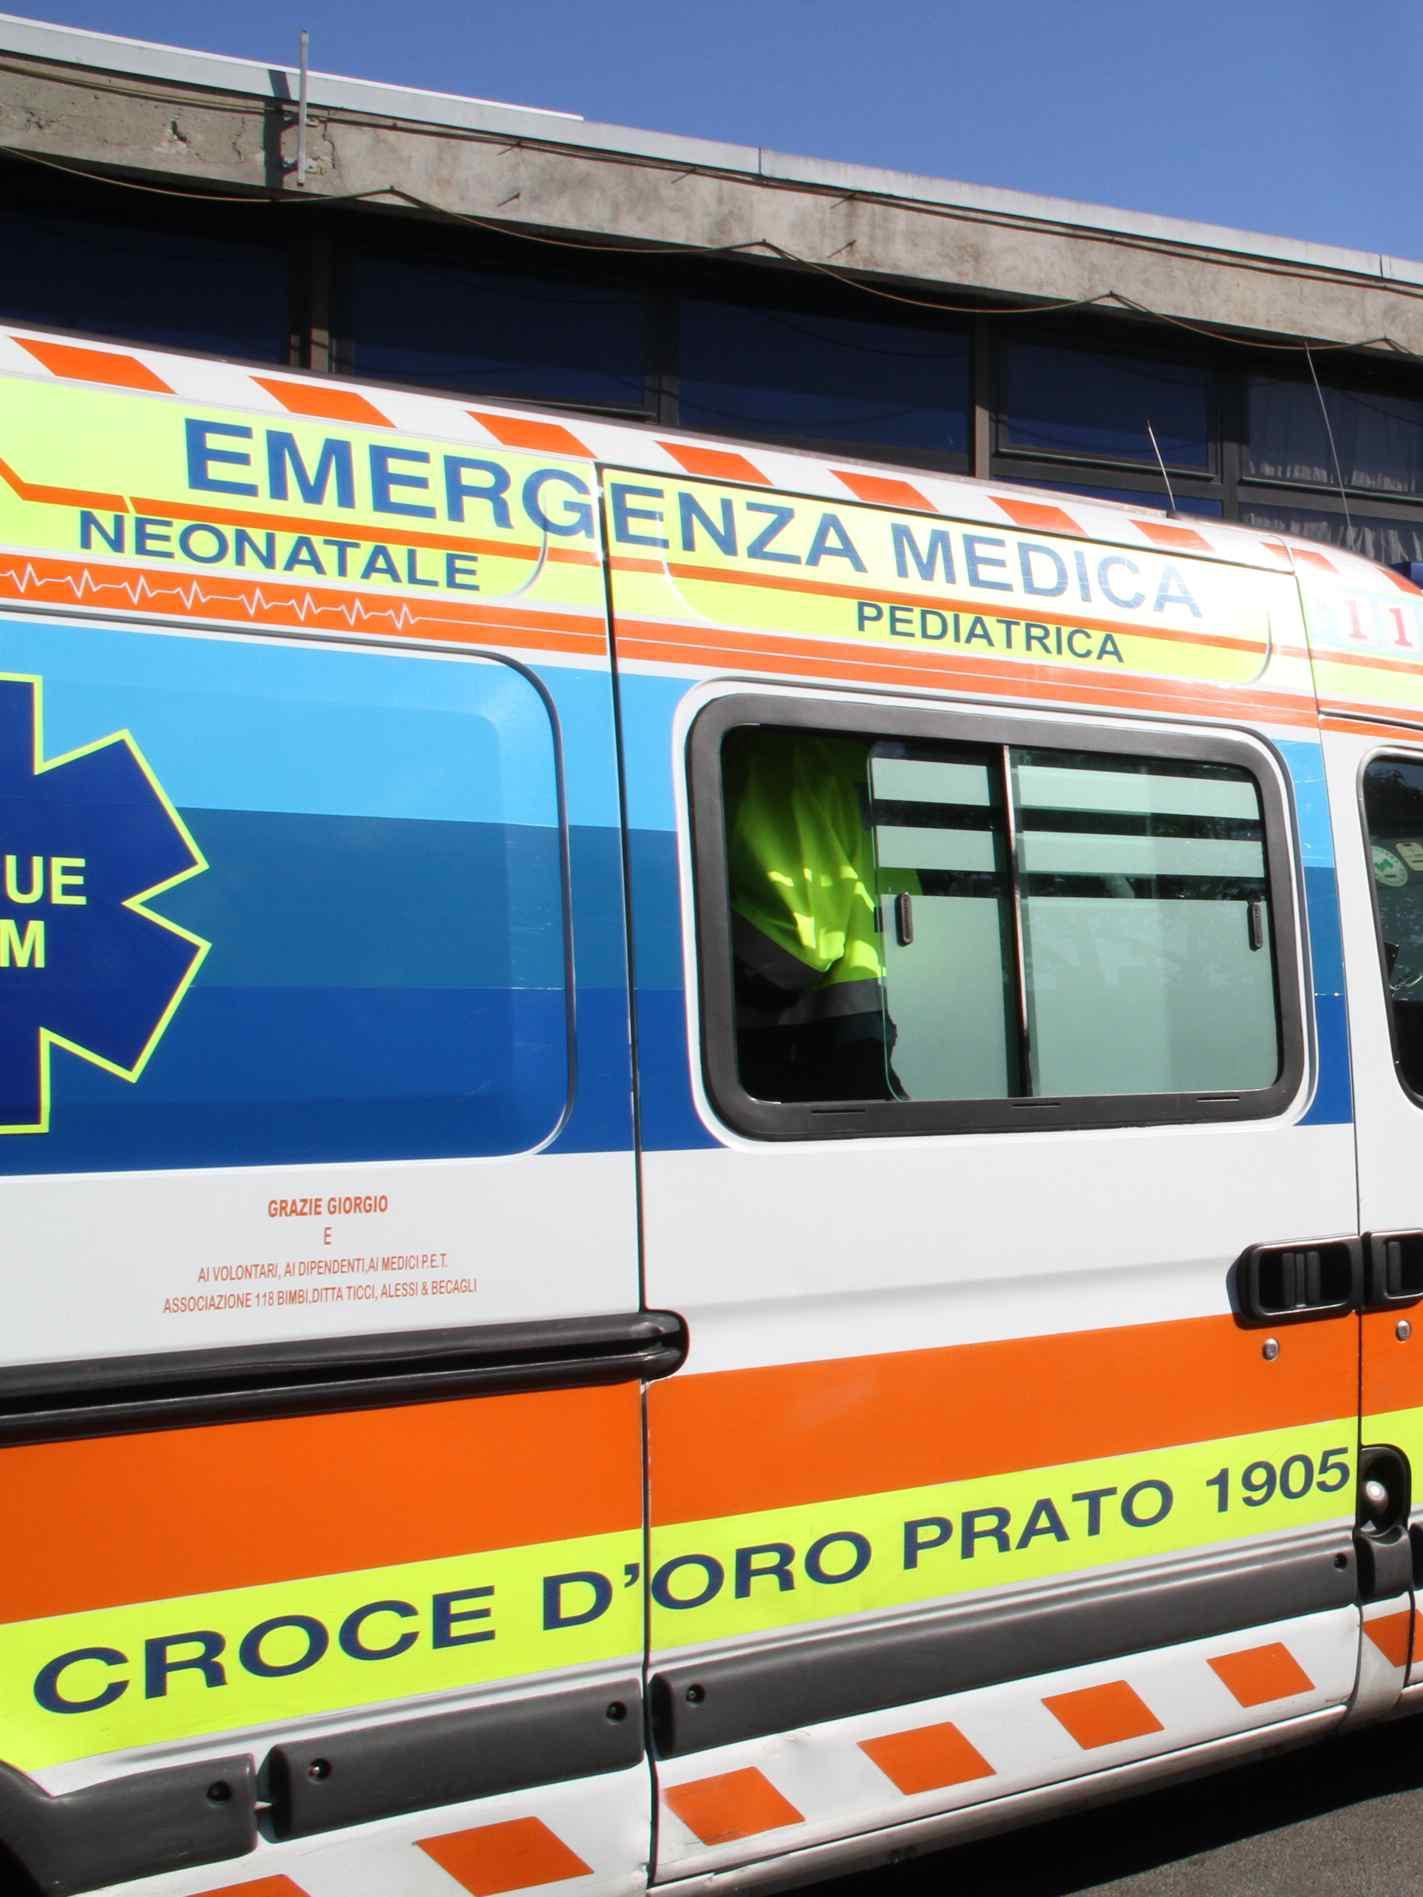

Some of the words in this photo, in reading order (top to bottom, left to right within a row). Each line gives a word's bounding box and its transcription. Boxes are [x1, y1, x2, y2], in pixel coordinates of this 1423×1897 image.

[184, 417, 868, 575] EMERGENZA
[892, 521, 1203, 619] MEDICA
[80, 510, 481, 591] NEONATALE
[856, 601, 1125, 664] PEDIATRICA
[268, 1198, 323, 1217] GRAZIE
[327, 1195, 388, 1215] GIORGIO
[323, 1226, 333, 1246] E
[197, 1266, 209, 1283] AI
[212, 1263, 282, 1281] VOLONTARI,
[284, 1261, 296, 1278] AI
[382, 1255, 419, 1272] MEDICI
[163, 1292, 252, 1314] ASSOCIAZIONE
[256, 1291, 275, 1308] 118
[345, 1284, 379, 1302] TICCI,
[380, 1281, 419, 1299] ALESSI
[420, 1280, 429, 1297] &
[431, 1277, 478, 1296] BECAGLI
[34, 1584, 497, 1715] CROCE
[902, 1478, 1175, 1570] PRATO
[1205, 1447, 1351, 1513] 1905
